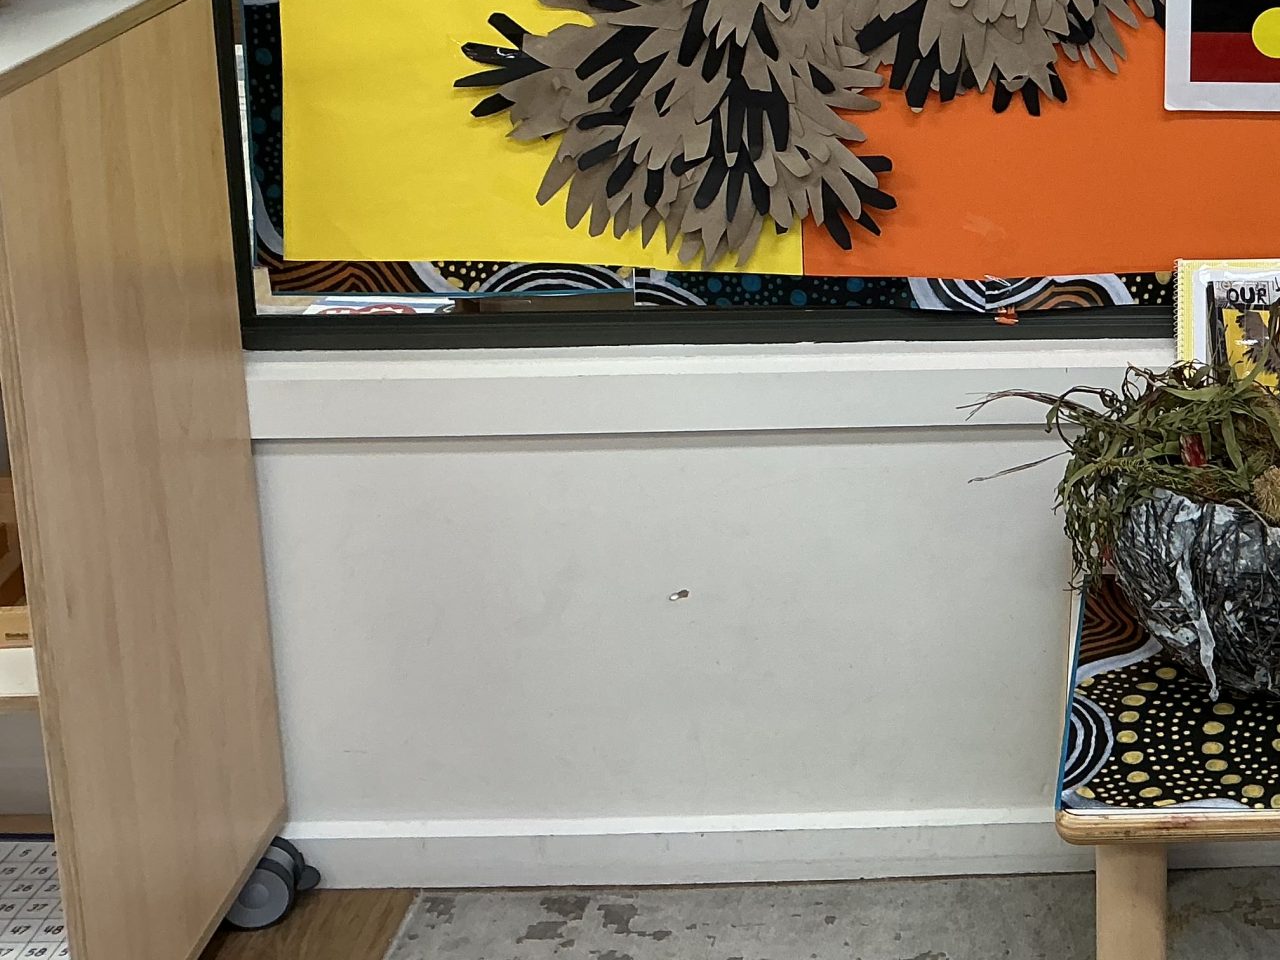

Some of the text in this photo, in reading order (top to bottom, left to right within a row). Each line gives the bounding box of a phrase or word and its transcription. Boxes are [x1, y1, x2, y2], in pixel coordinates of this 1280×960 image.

[1226, 287, 1268, 305] OUR
[19, 849, 32, 857] 5
[30, 866, 49, 875] 16
[12, 884, 34, 893] 26
[26, 903, 49, 912] 37
[10, 925, 64, 935] 47 48
[25, 947, 48, 957] 58
